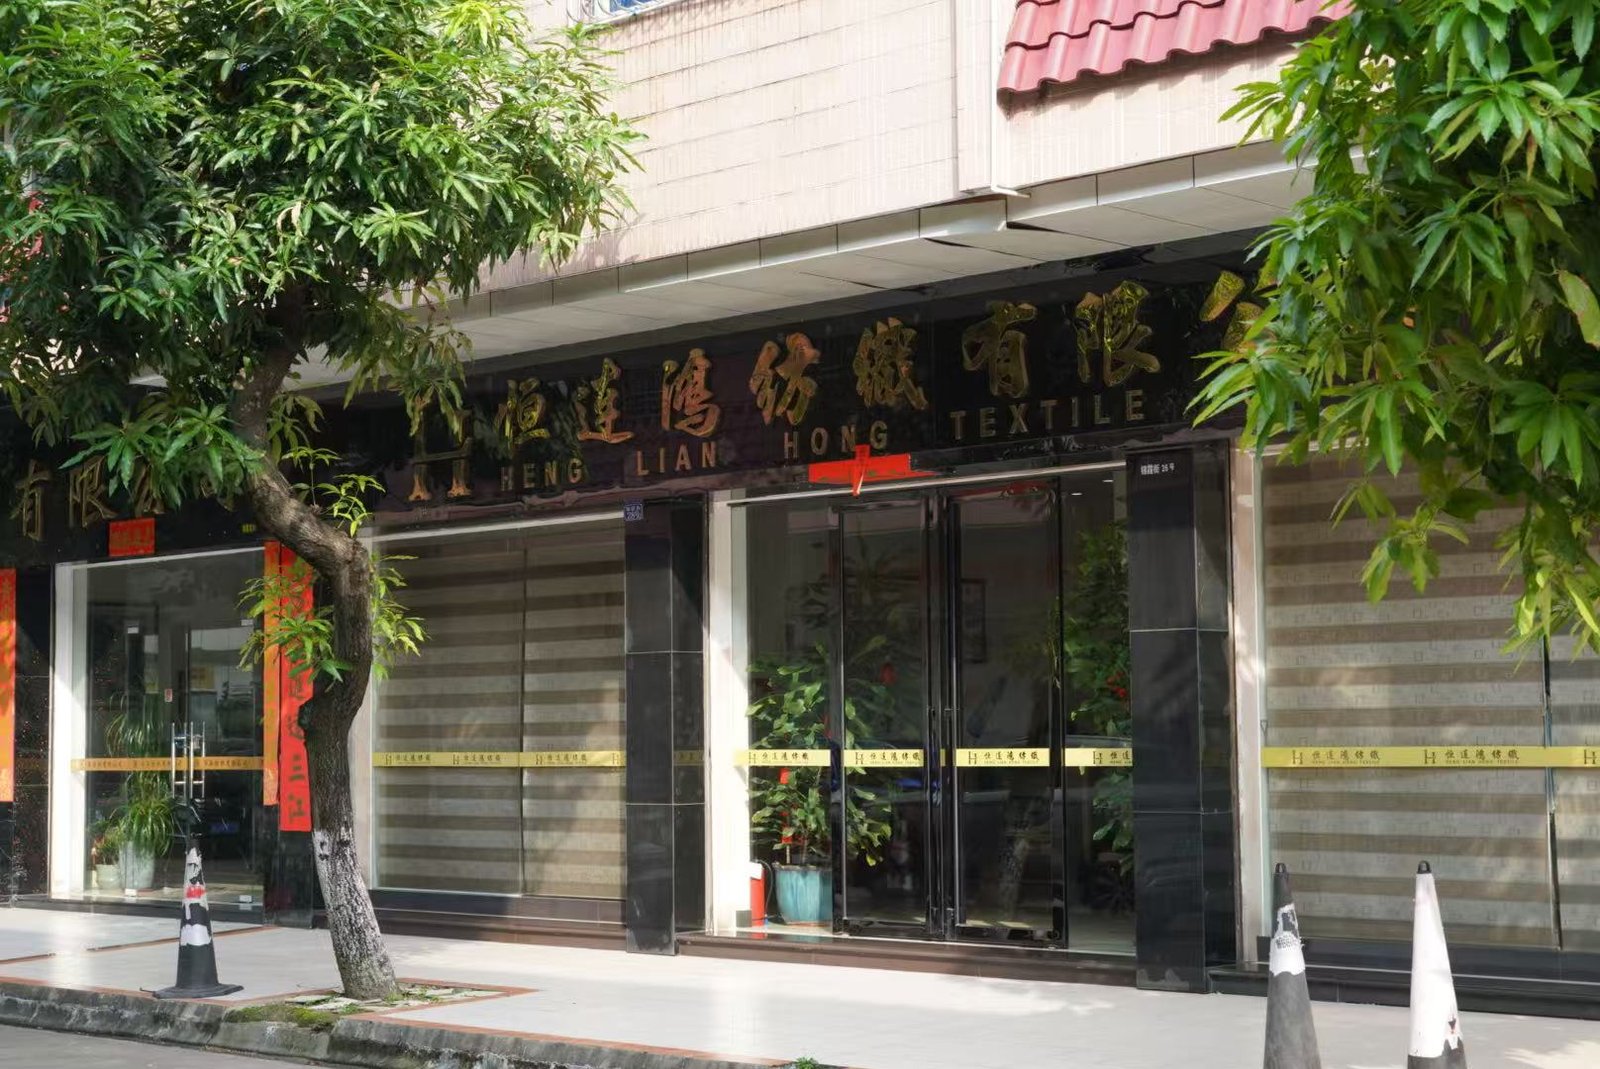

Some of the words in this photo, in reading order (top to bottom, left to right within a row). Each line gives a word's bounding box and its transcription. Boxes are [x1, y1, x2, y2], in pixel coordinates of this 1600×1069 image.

[500, 458, 583, 492] HENG
[636, 441, 716, 476] LIAN
[784, 421, 888, 459] HONG
[950, 389, 1145, 440] TEXTILE
